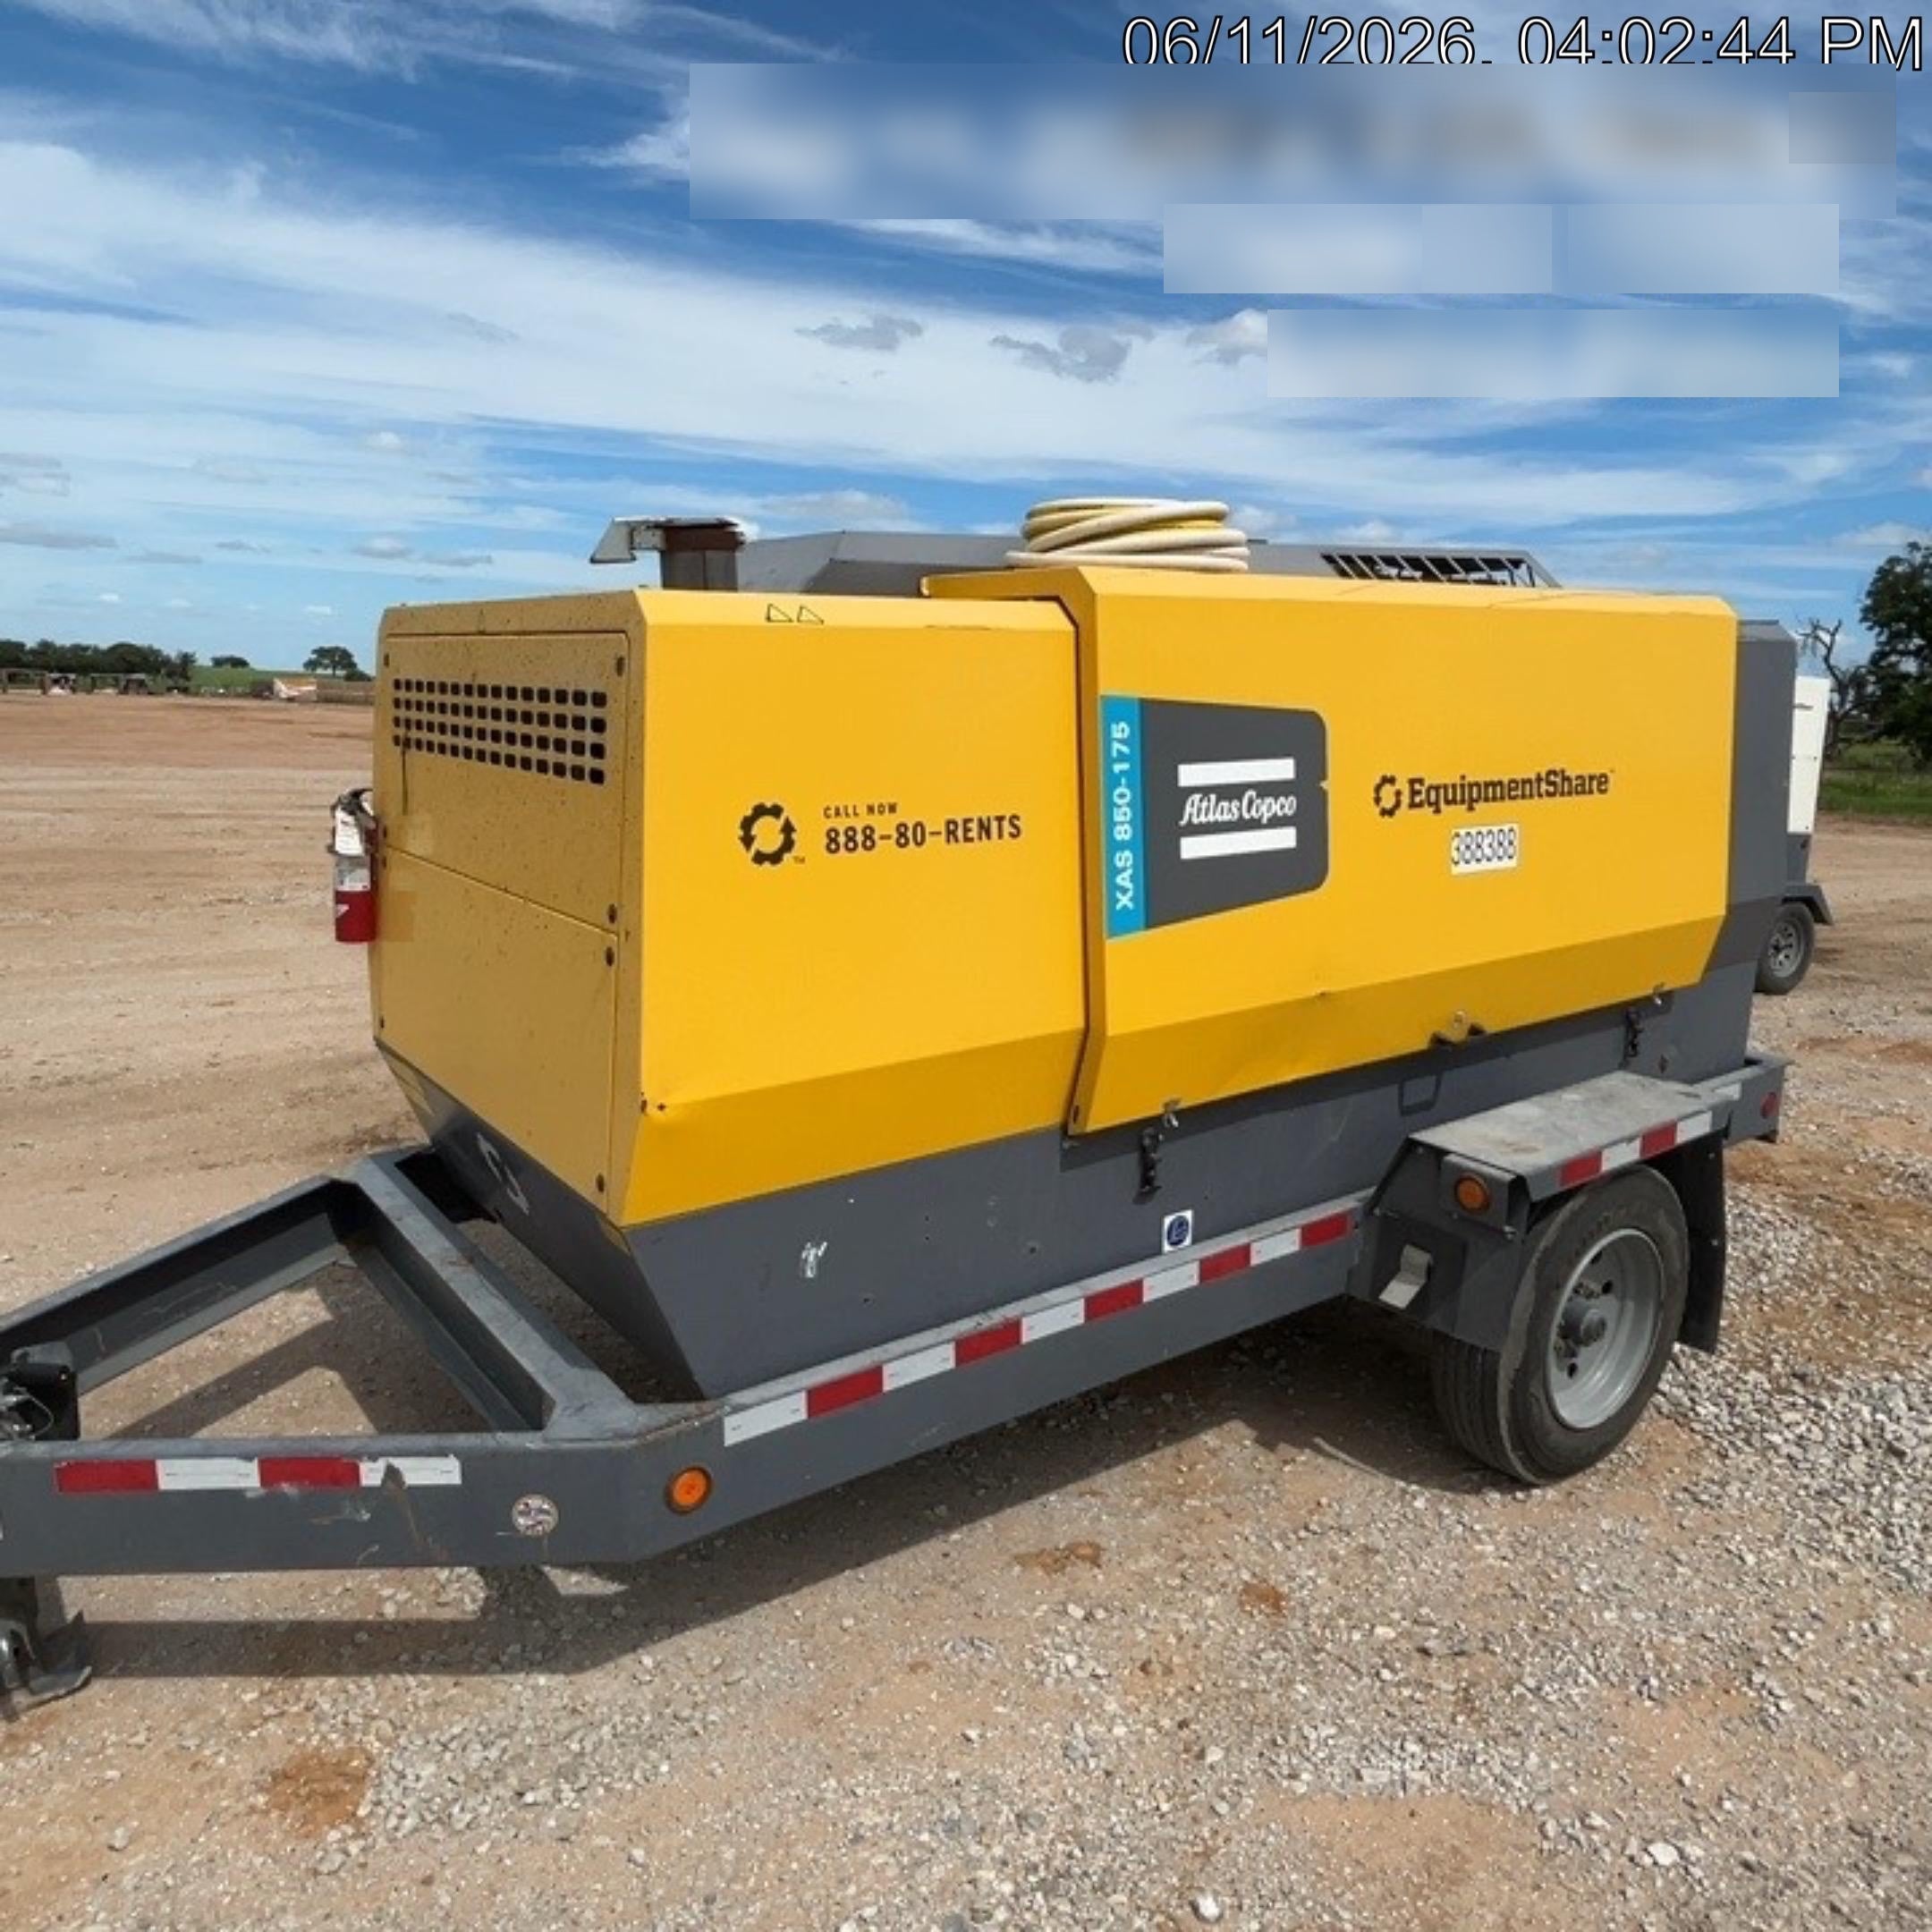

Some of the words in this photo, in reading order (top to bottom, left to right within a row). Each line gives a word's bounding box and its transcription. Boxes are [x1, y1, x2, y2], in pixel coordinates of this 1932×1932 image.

[1111, 721, 1132, 841] 850-175
[1408, 768, 1609, 813] EquipmentShare
[823, 805, 860, 819] CALL
[866, 802, 898, 816] NOW
[826, 814, 1021, 854] 888-80-RENTS
[1451, 827, 1516, 865] 388388
[1115, 851, 1133, 910] XAS
